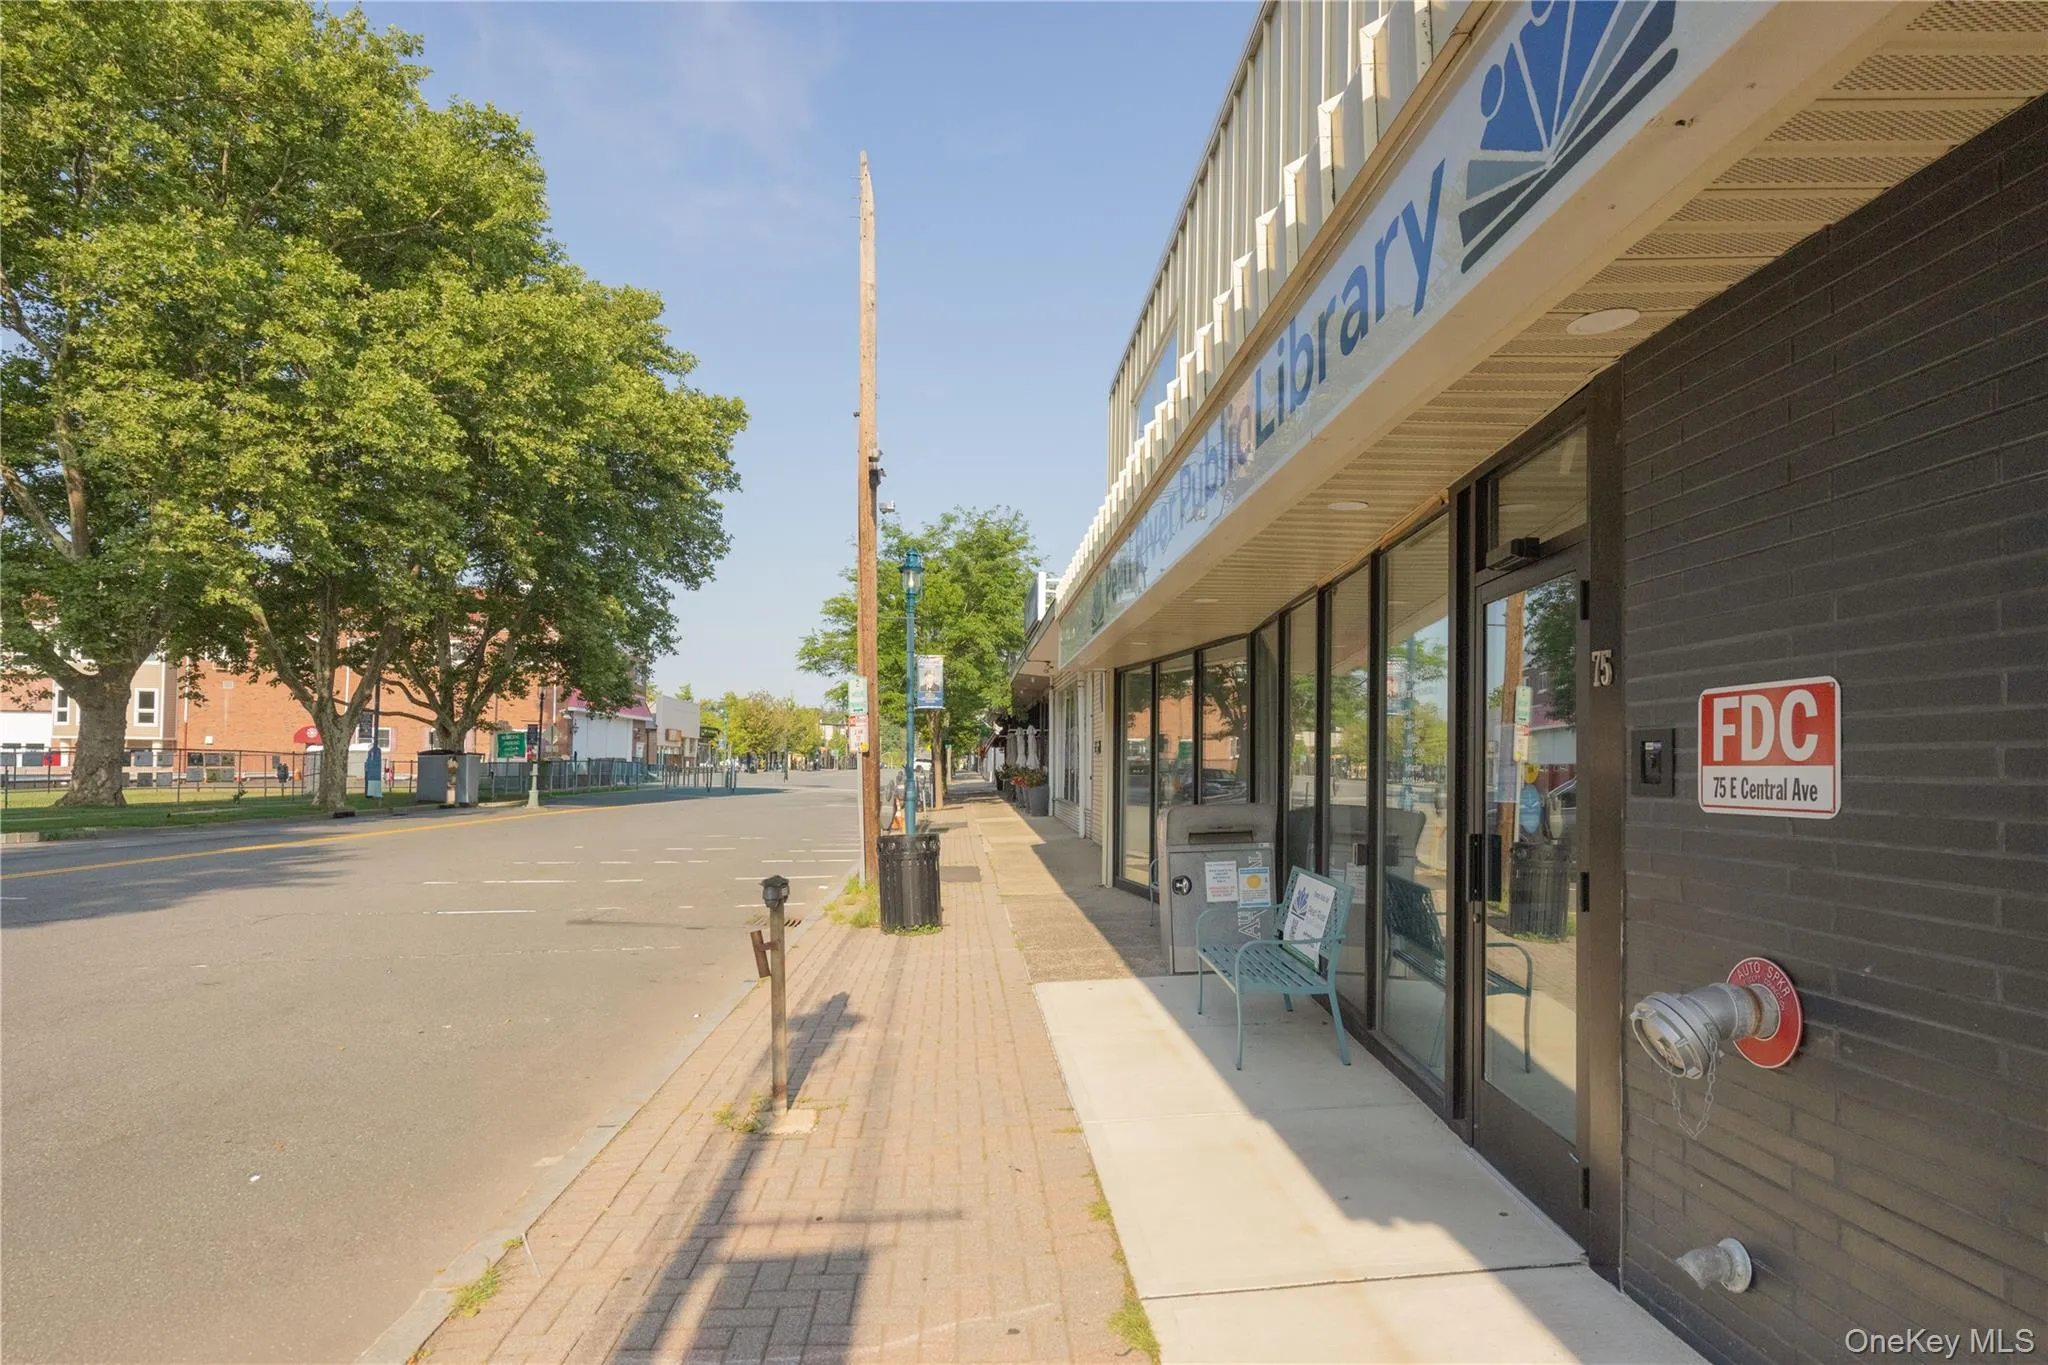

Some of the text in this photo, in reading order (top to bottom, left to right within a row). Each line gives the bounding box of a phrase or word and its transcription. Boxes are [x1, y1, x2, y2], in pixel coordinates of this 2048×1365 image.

[1181, 402, 1249, 527] Public
[1255, 157, 1446, 450] Library
[1591, 649, 1613, 688] 75
[1712, 688, 1819, 762] FDC
[1713, 776, 1819, 802] 75 E Central Ave
[1737, 961, 1761, 981] AUTO
[1767, 966, 1791, 998] SPKR
